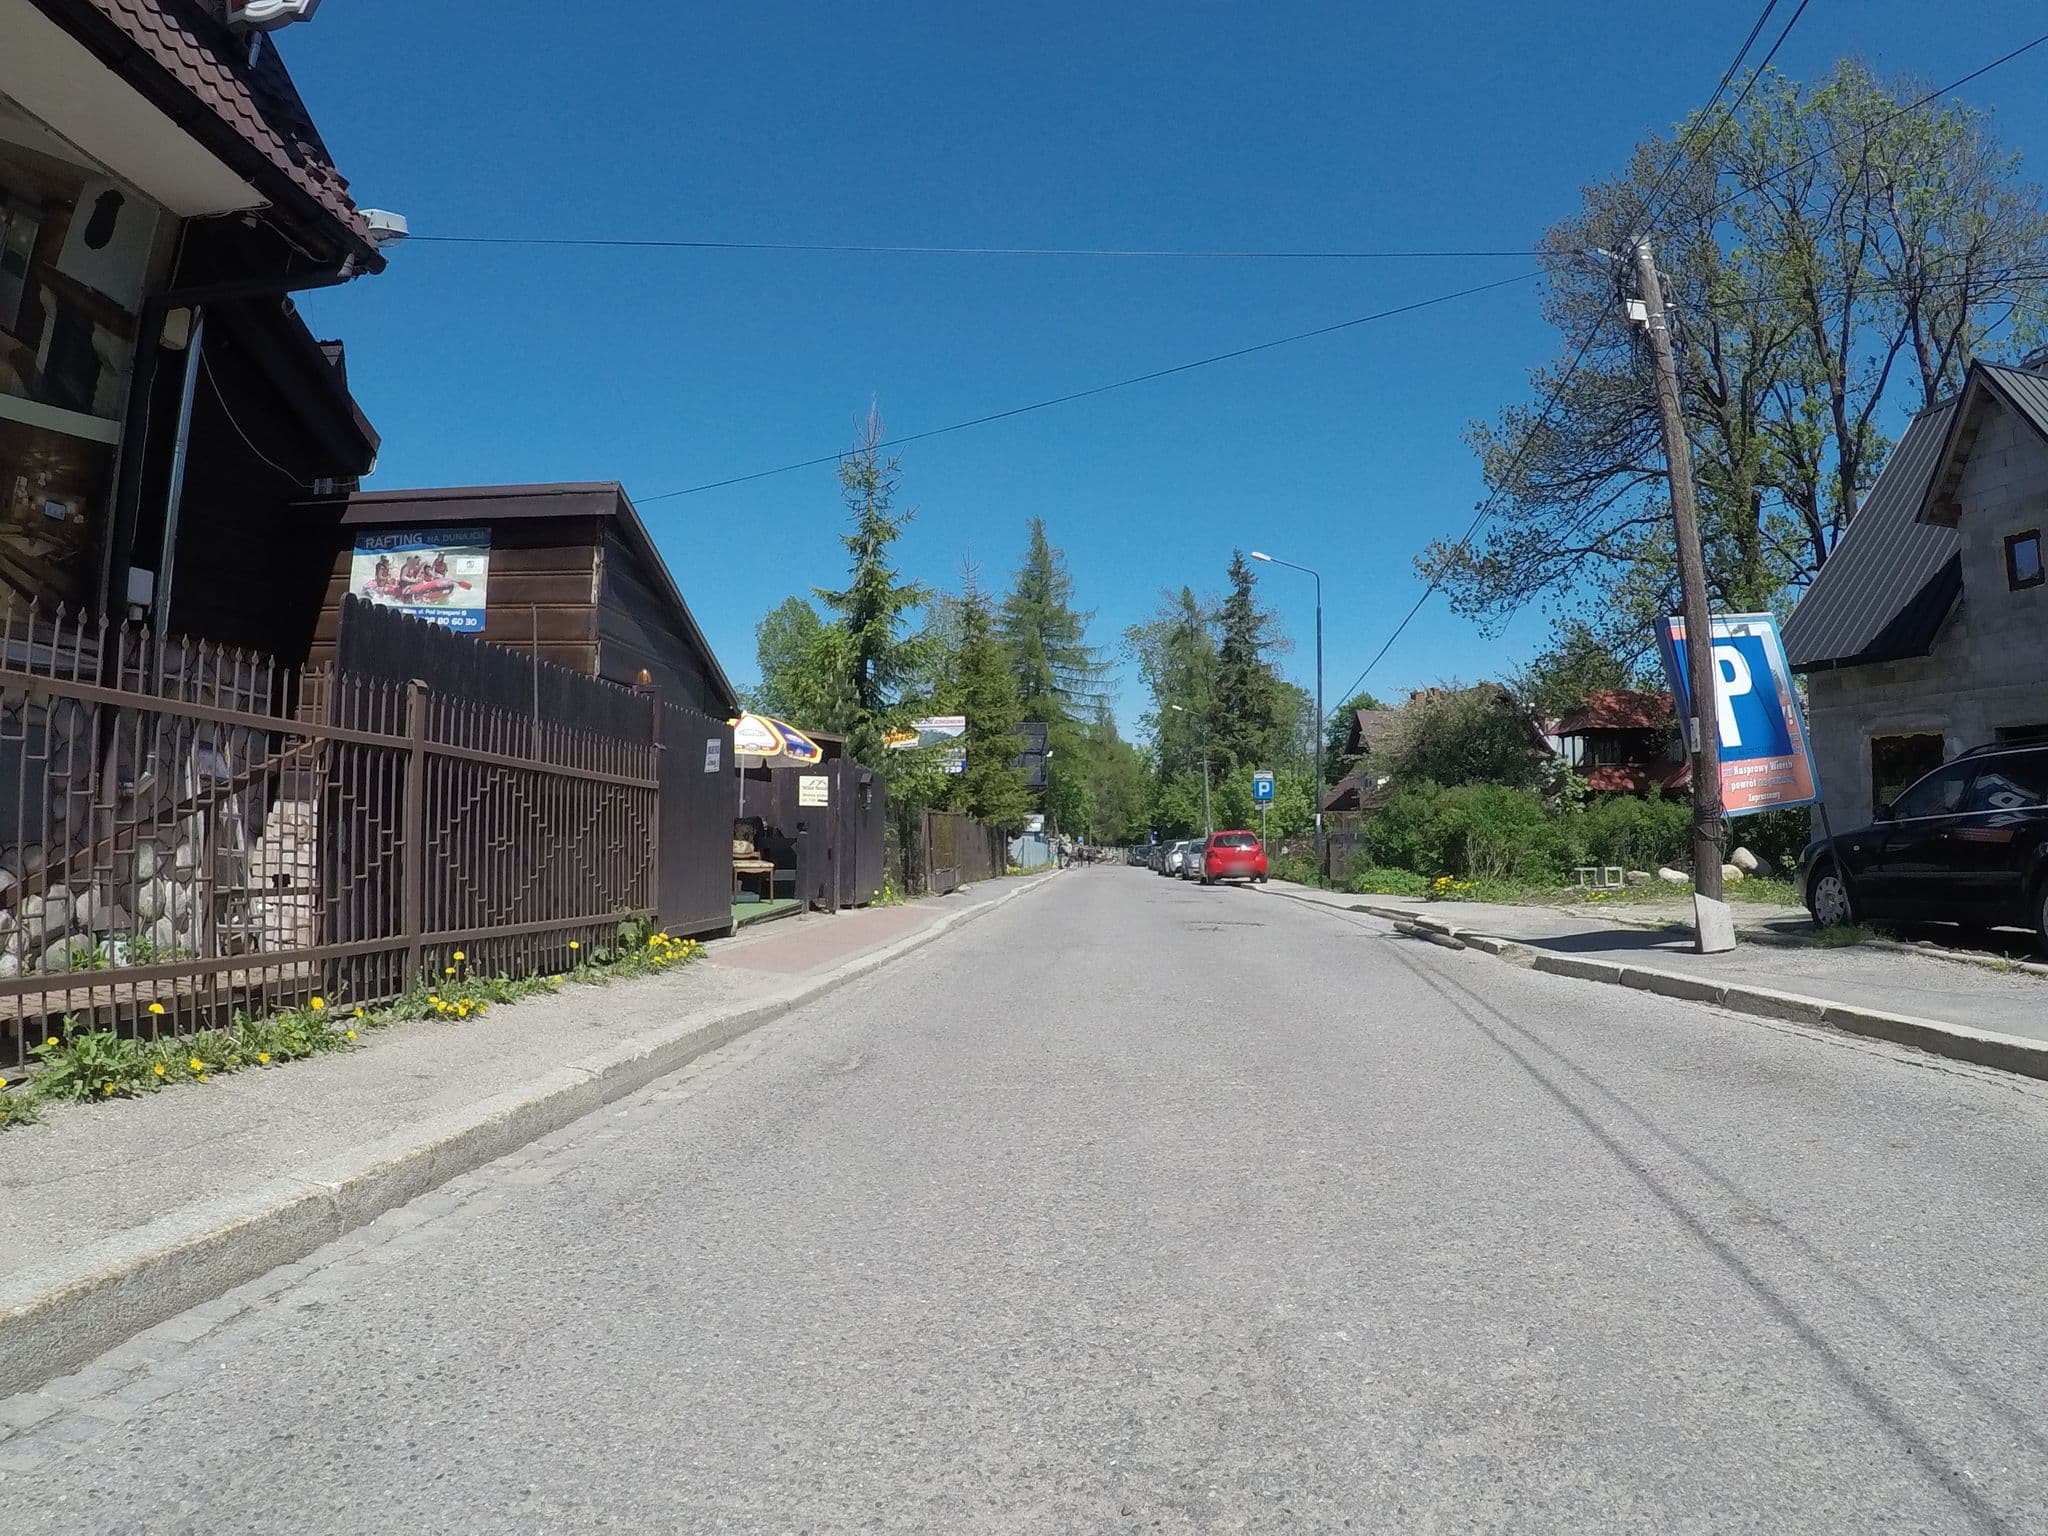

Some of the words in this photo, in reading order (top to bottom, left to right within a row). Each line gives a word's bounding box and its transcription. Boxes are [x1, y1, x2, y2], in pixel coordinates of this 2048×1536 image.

[365, 533, 422, 548] RAFTING
[427, 535, 440, 543] NA
[451, 618, 463, 626] 60
[465, 618, 477, 626] 30
[1711, 645, 1752, 747] P
[1258, 782, 1270, 796] P
